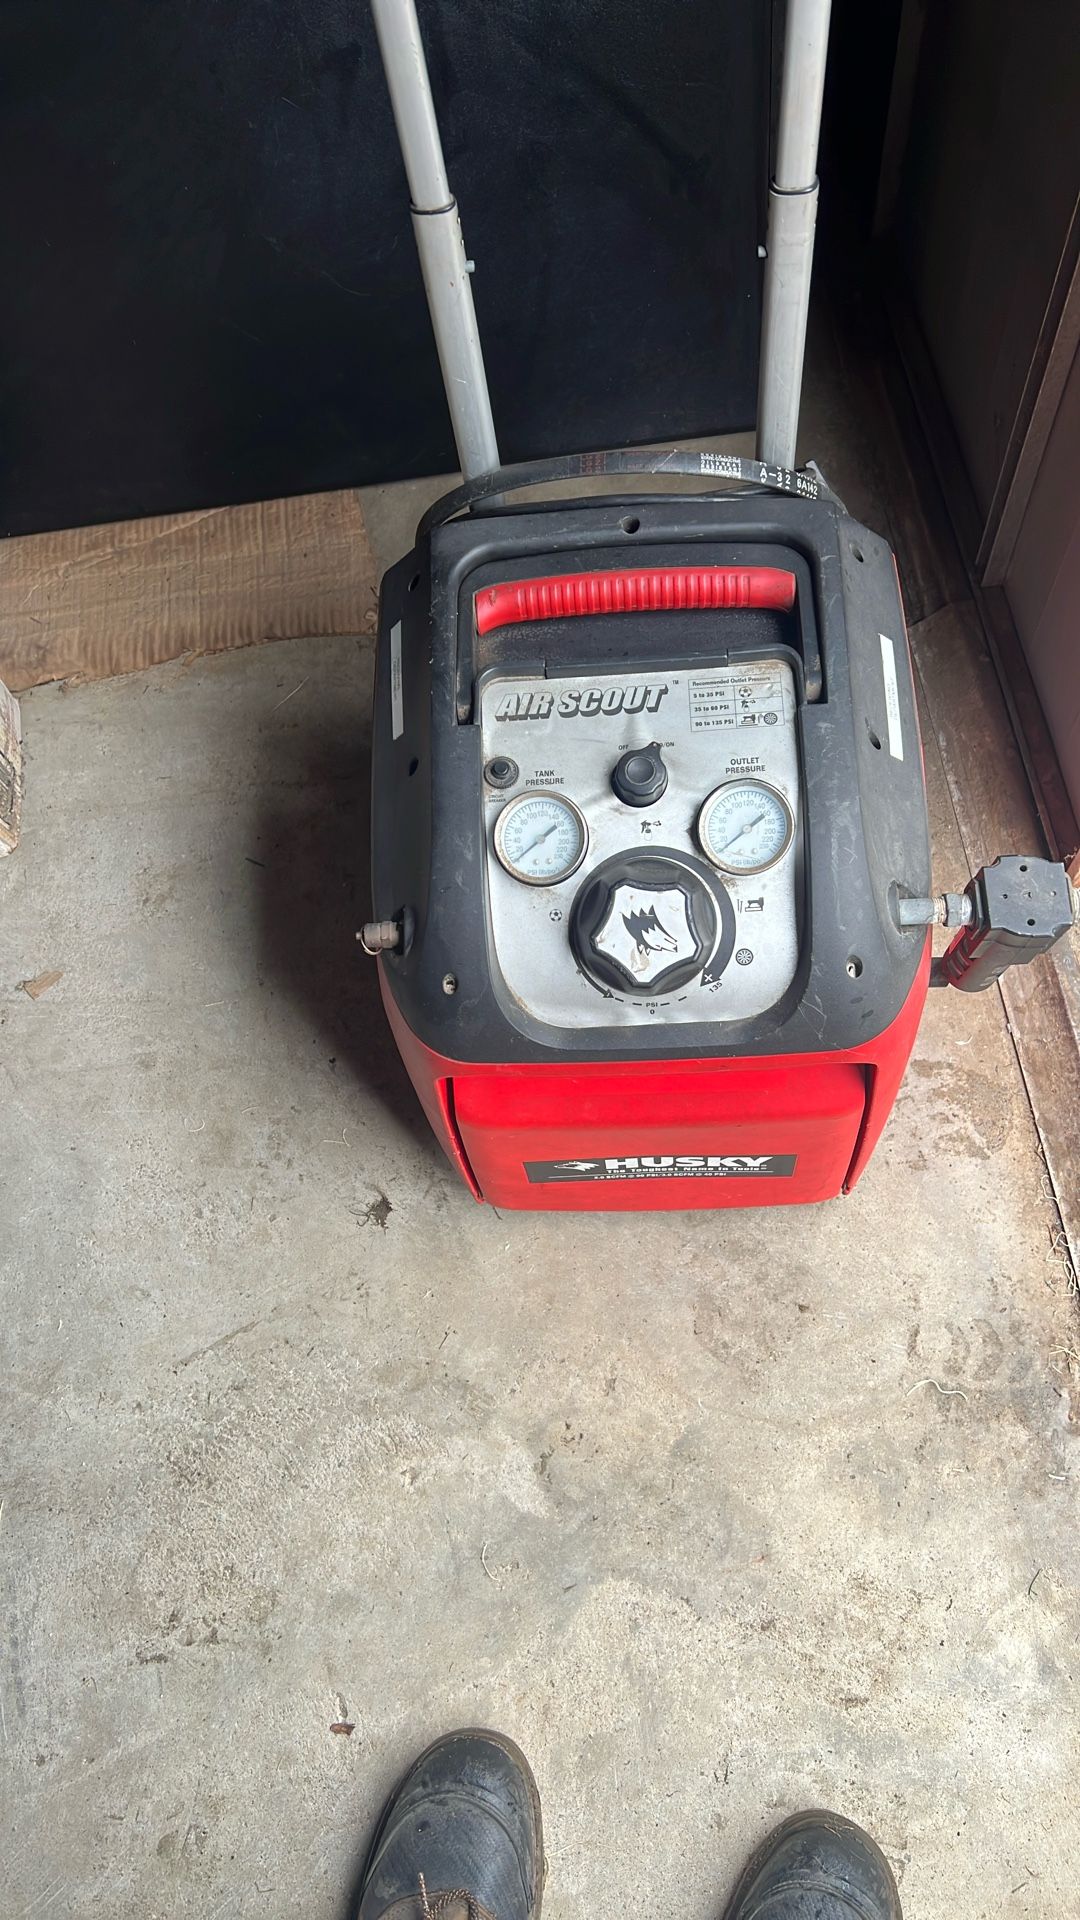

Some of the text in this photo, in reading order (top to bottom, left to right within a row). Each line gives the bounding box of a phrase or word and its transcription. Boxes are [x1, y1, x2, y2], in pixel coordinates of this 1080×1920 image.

[796, 478, 818, 496] 6A142
[692, 679, 729, 687] Recommended
[494, 692, 554, 722] AIR
[556, 684, 669, 719] SCOUT
[730, 757, 760, 766] OUTLET
[534, 770, 556, 778] TANK
[725, 765, 766, 775] PRESSURE
[525, 778, 565, 786] PRESSURE
[708, 981, 724, 994] 135
[605, 1156, 773, 1170] HUSKY
